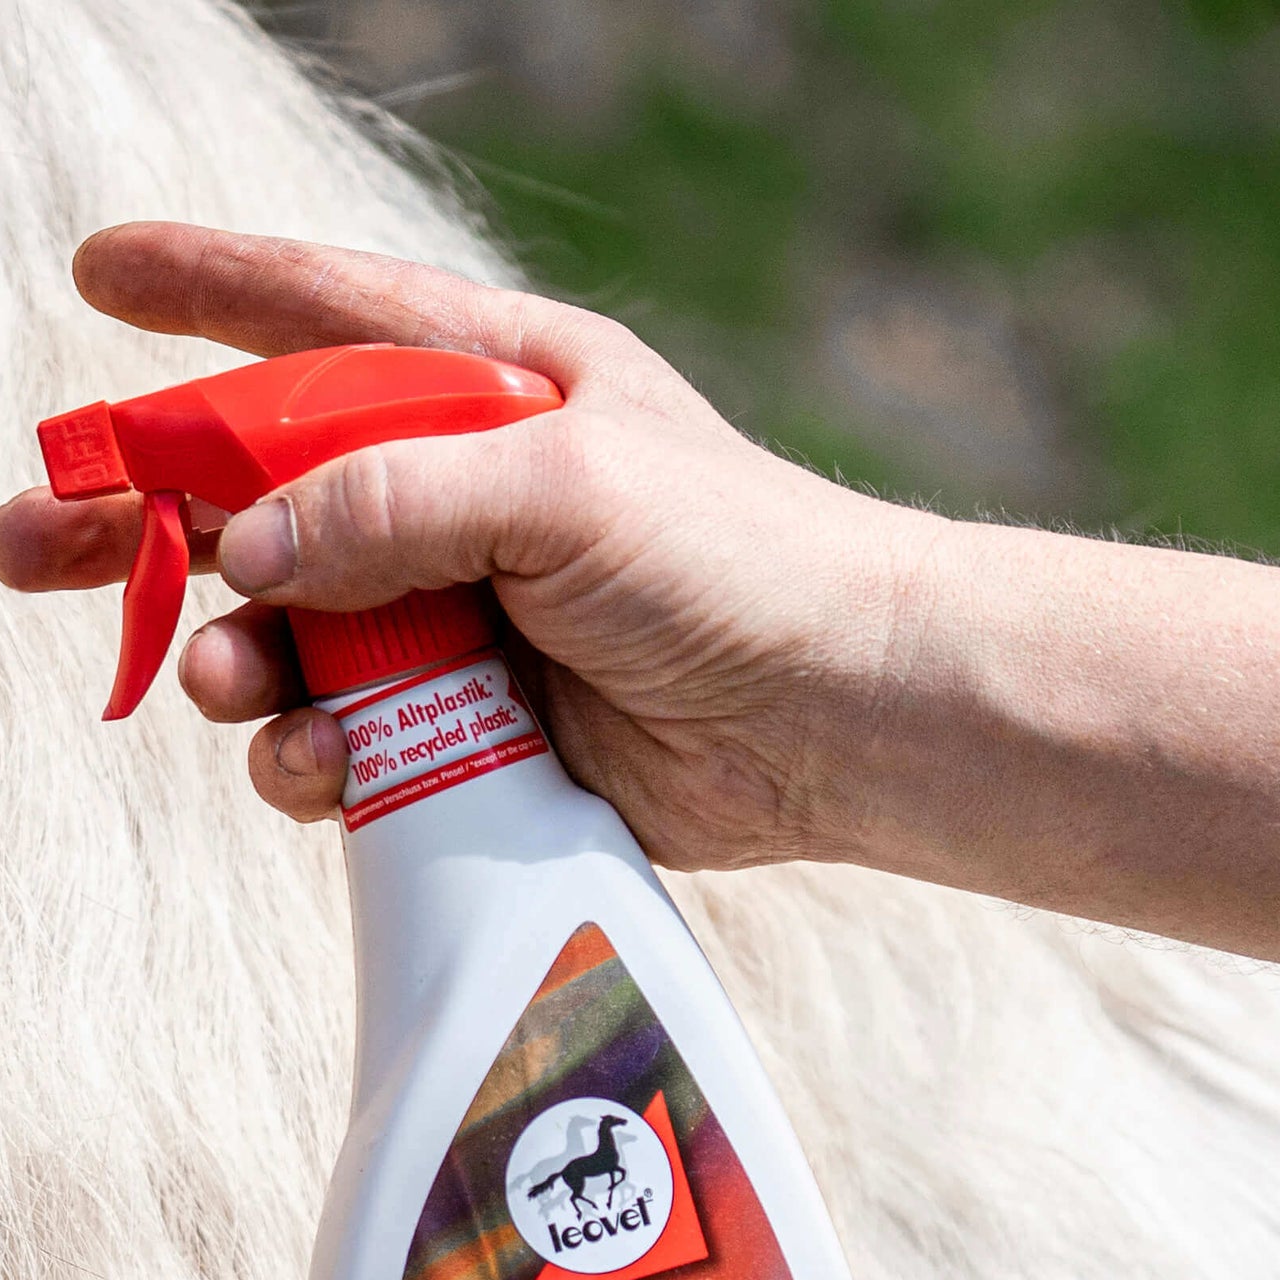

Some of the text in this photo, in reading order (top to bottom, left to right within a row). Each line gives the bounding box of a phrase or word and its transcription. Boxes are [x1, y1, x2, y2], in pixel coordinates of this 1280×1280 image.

[352, 749, 397, 785] 100%
[399, 719, 468, 766] recycled
[441, 766, 464, 781] Pinsel
